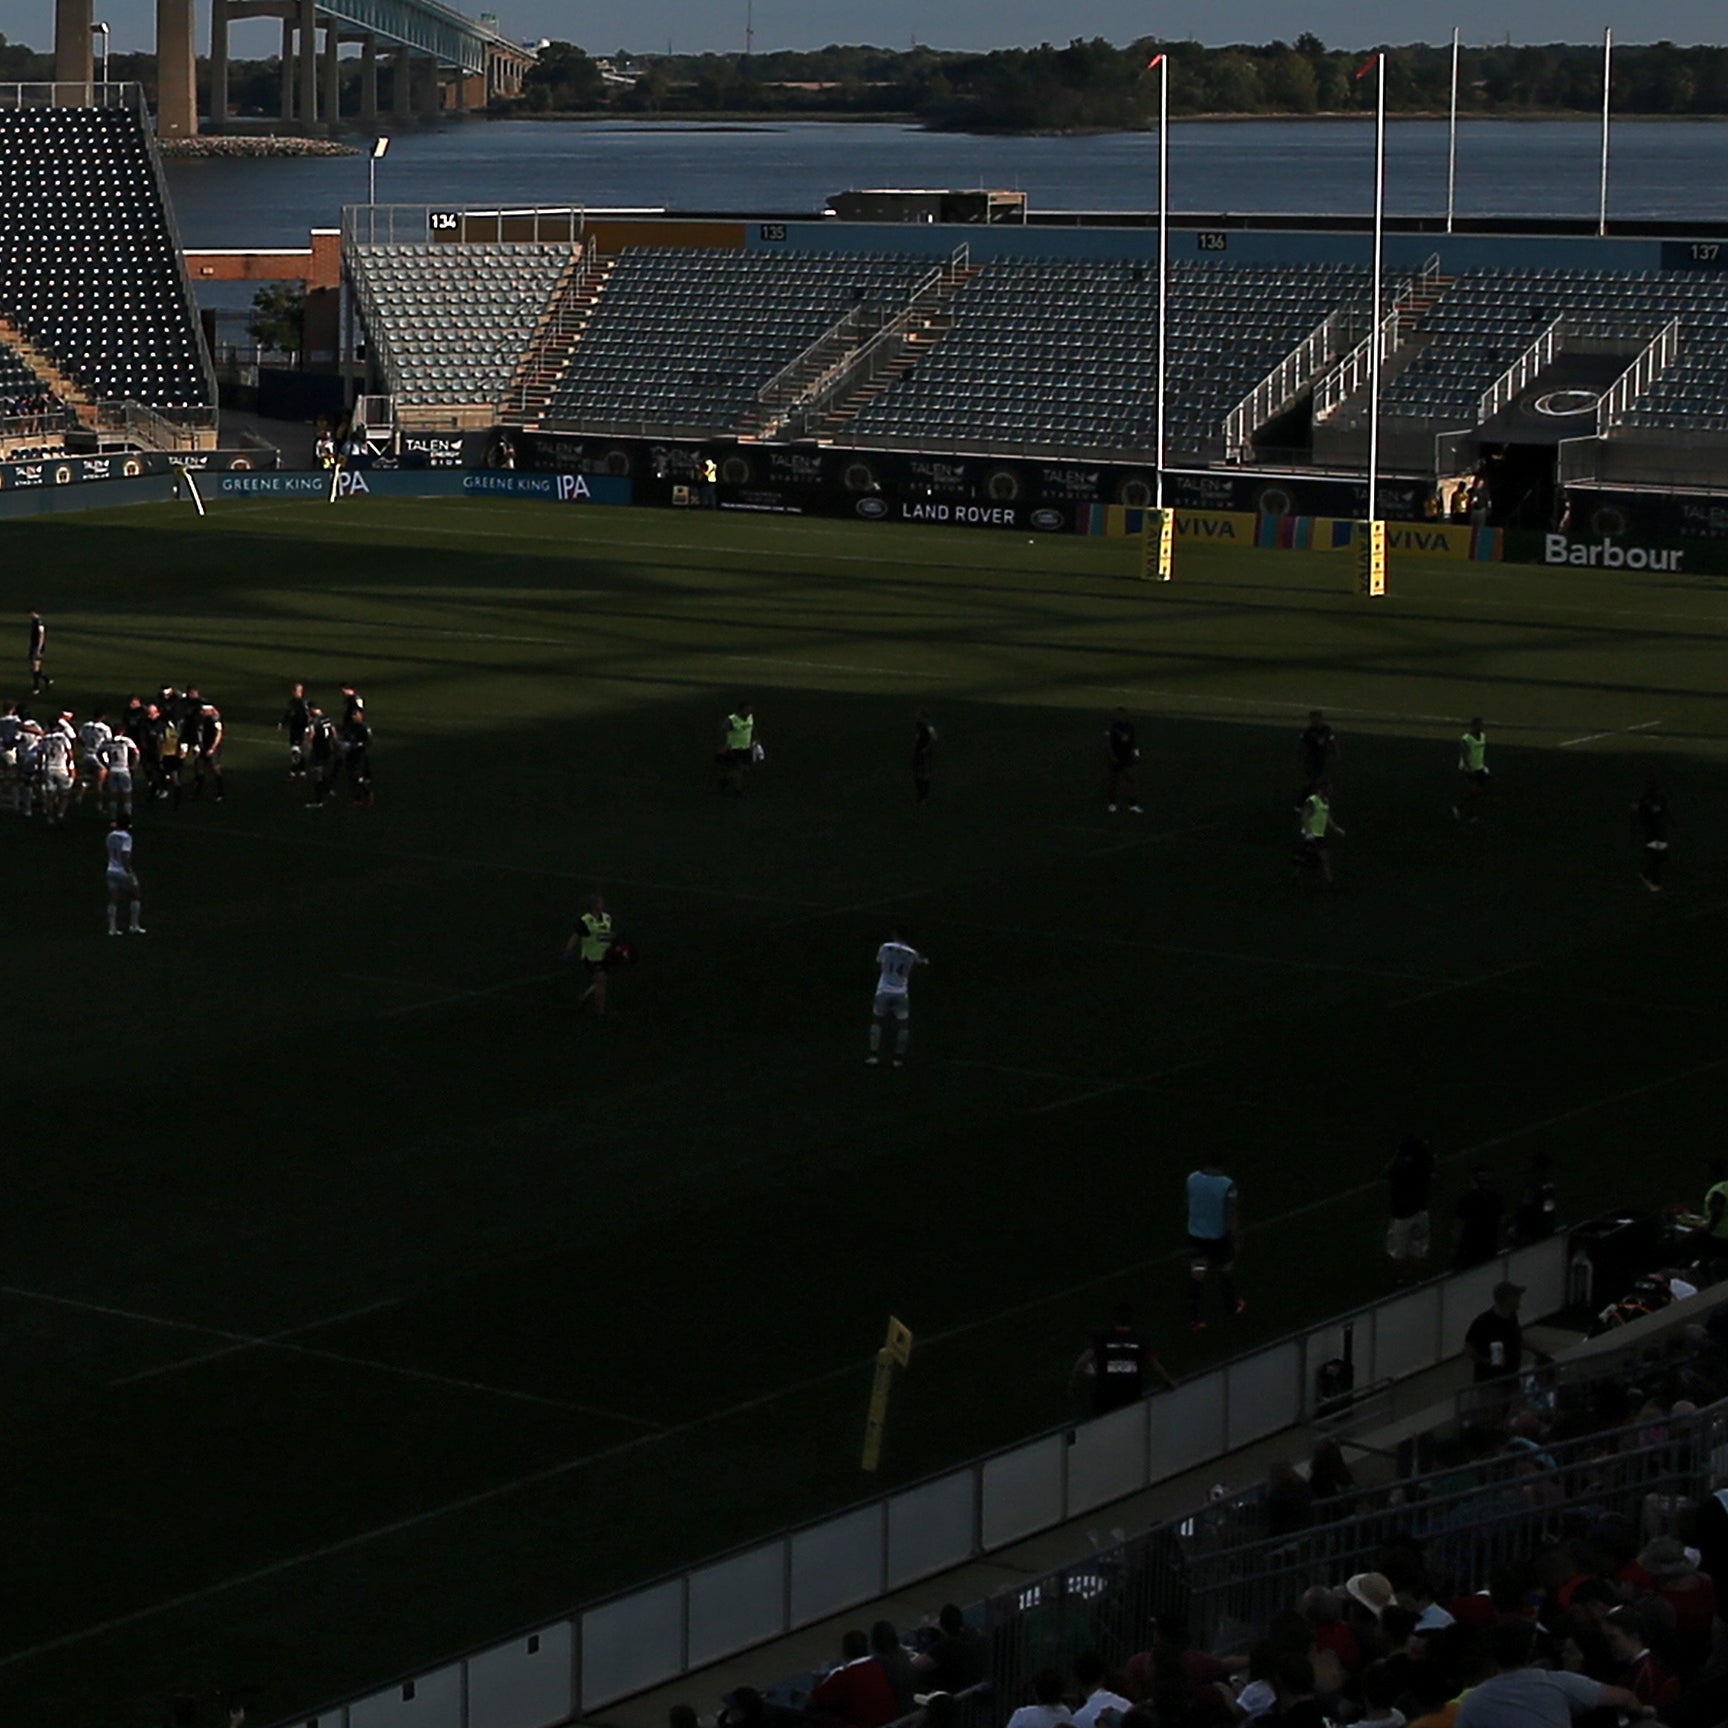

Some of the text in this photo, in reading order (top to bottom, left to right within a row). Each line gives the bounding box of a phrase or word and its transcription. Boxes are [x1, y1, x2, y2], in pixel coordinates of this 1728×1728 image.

[432, 213, 457, 229] 134
[763, 225, 785, 240] 135
[1199, 235, 1225, 250] 136
[1691, 244, 1720, 261] 137
[406, 439, 450, 452] TALEN
[222, 470, 371, 497] GREENE KING PA
[463, 473, 591, 501] GREENE KING IPA
[1177, 478, 1223, 491] TALEN
[1353, 488, 1401, 502] TAEN
[902, 503, 1016, 525] LAND ROVER
[1176, 518, 1236, 539] VIVA
[1544, 532, 1684, 571] Barbour
